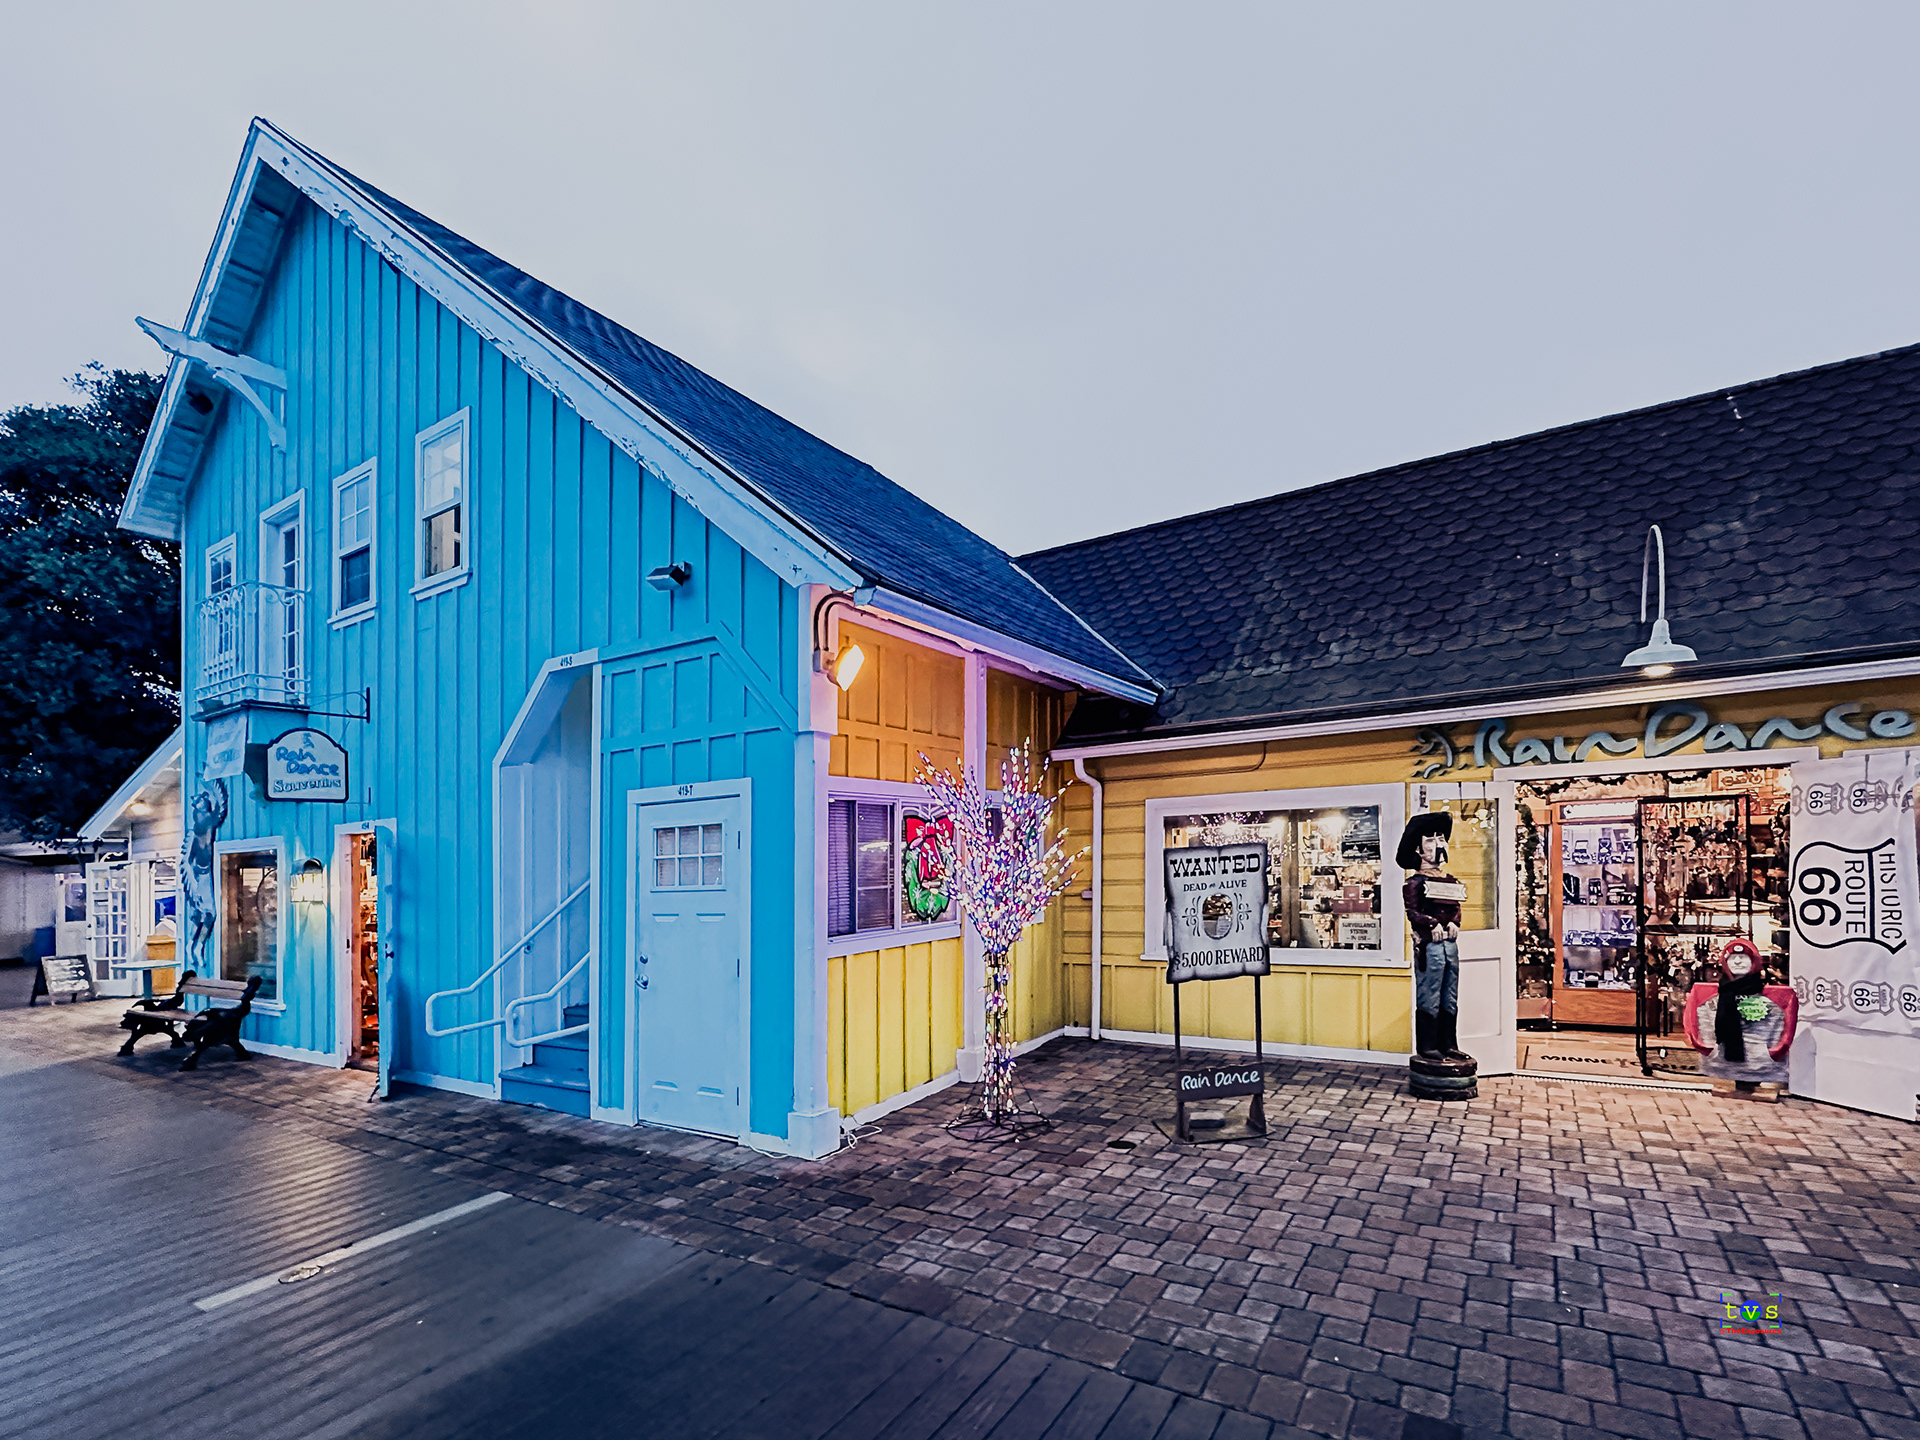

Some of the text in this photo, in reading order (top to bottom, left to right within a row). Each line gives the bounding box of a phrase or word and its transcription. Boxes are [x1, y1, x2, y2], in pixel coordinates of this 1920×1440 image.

[1473, 717, 1638, 768] Rain
[275, 746, 316, 762] Rain
[286, 760, 340, 776] Dance
[273, 777, 342, 794] Souvenirs
[1809, 790, 1824, 809] 66
[1169, 853, 1261, 878] WANTED
[1183, 882, 1208, 892] DEAD
[1218, 879, 1248, 890] ALIVE
[1798, 867, 1842, 926] 66
[1844, 860, 1866, 934] ROUTE
[1172, 946, 1265, 971] $5,000 REWARD
[1815, 983, 1825, 1003] 66
[1853, 987, 1870, 1007] 66
[1902, 992, 1917, 1013] 66
[1181, 1070, 1260, 1090] Rain Dance
